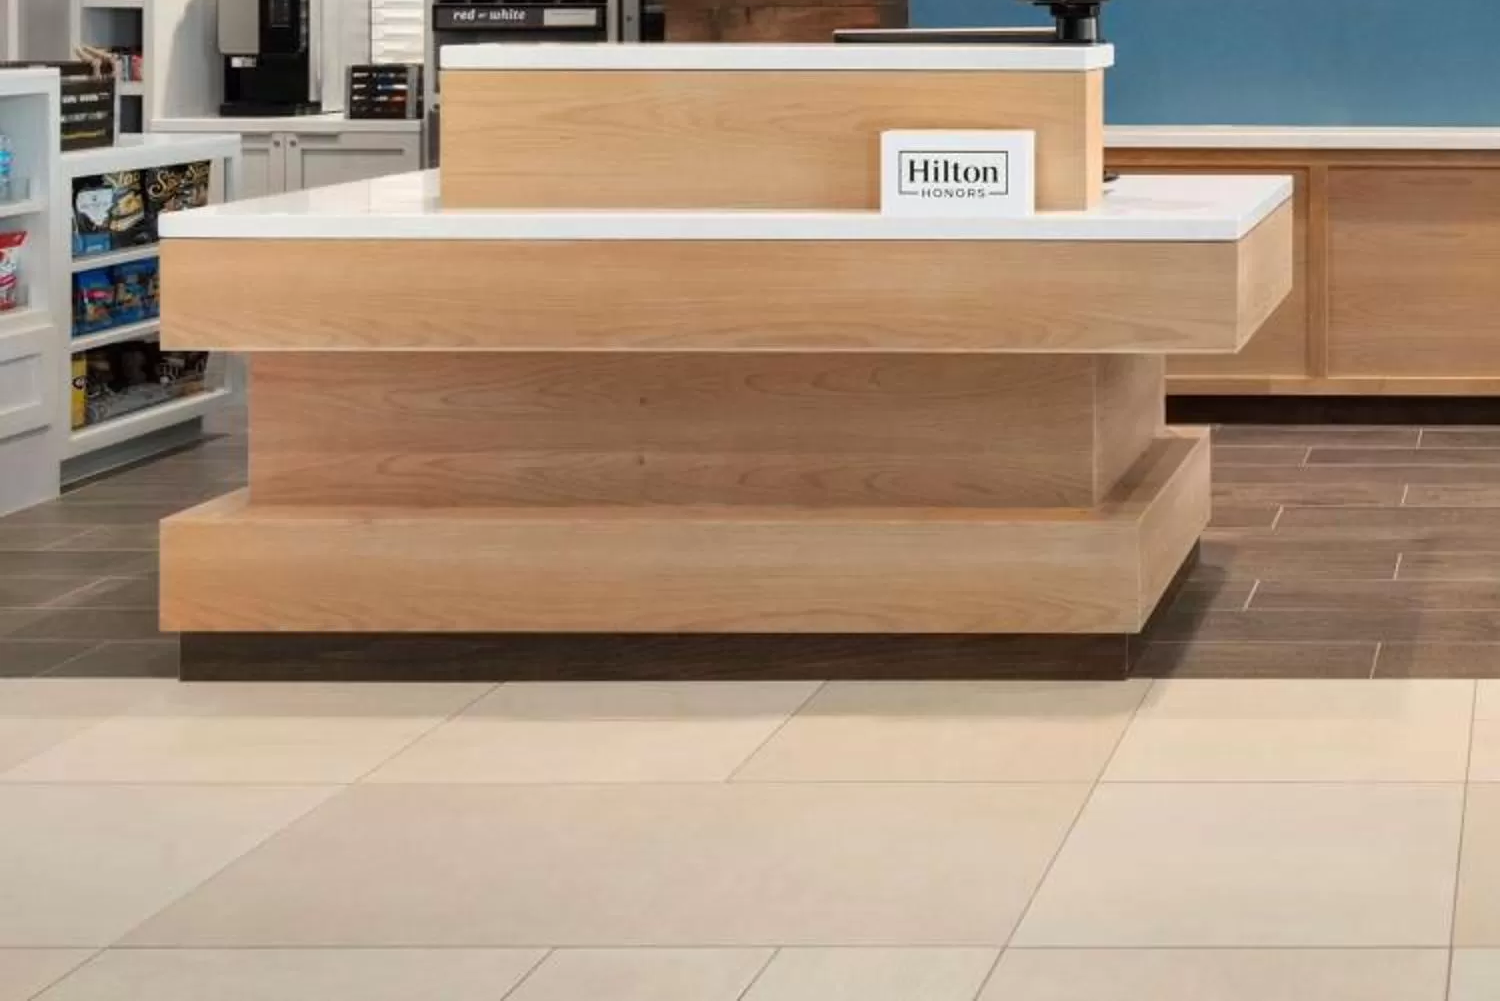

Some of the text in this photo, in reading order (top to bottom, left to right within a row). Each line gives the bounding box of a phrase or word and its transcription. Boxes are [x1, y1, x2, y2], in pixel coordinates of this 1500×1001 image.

[453, 9, 475, 20] red
[489, 9, 526, 20] white
[908, 159, 999, 183] Hilton
[921, 188, 986, 198] HONORS
